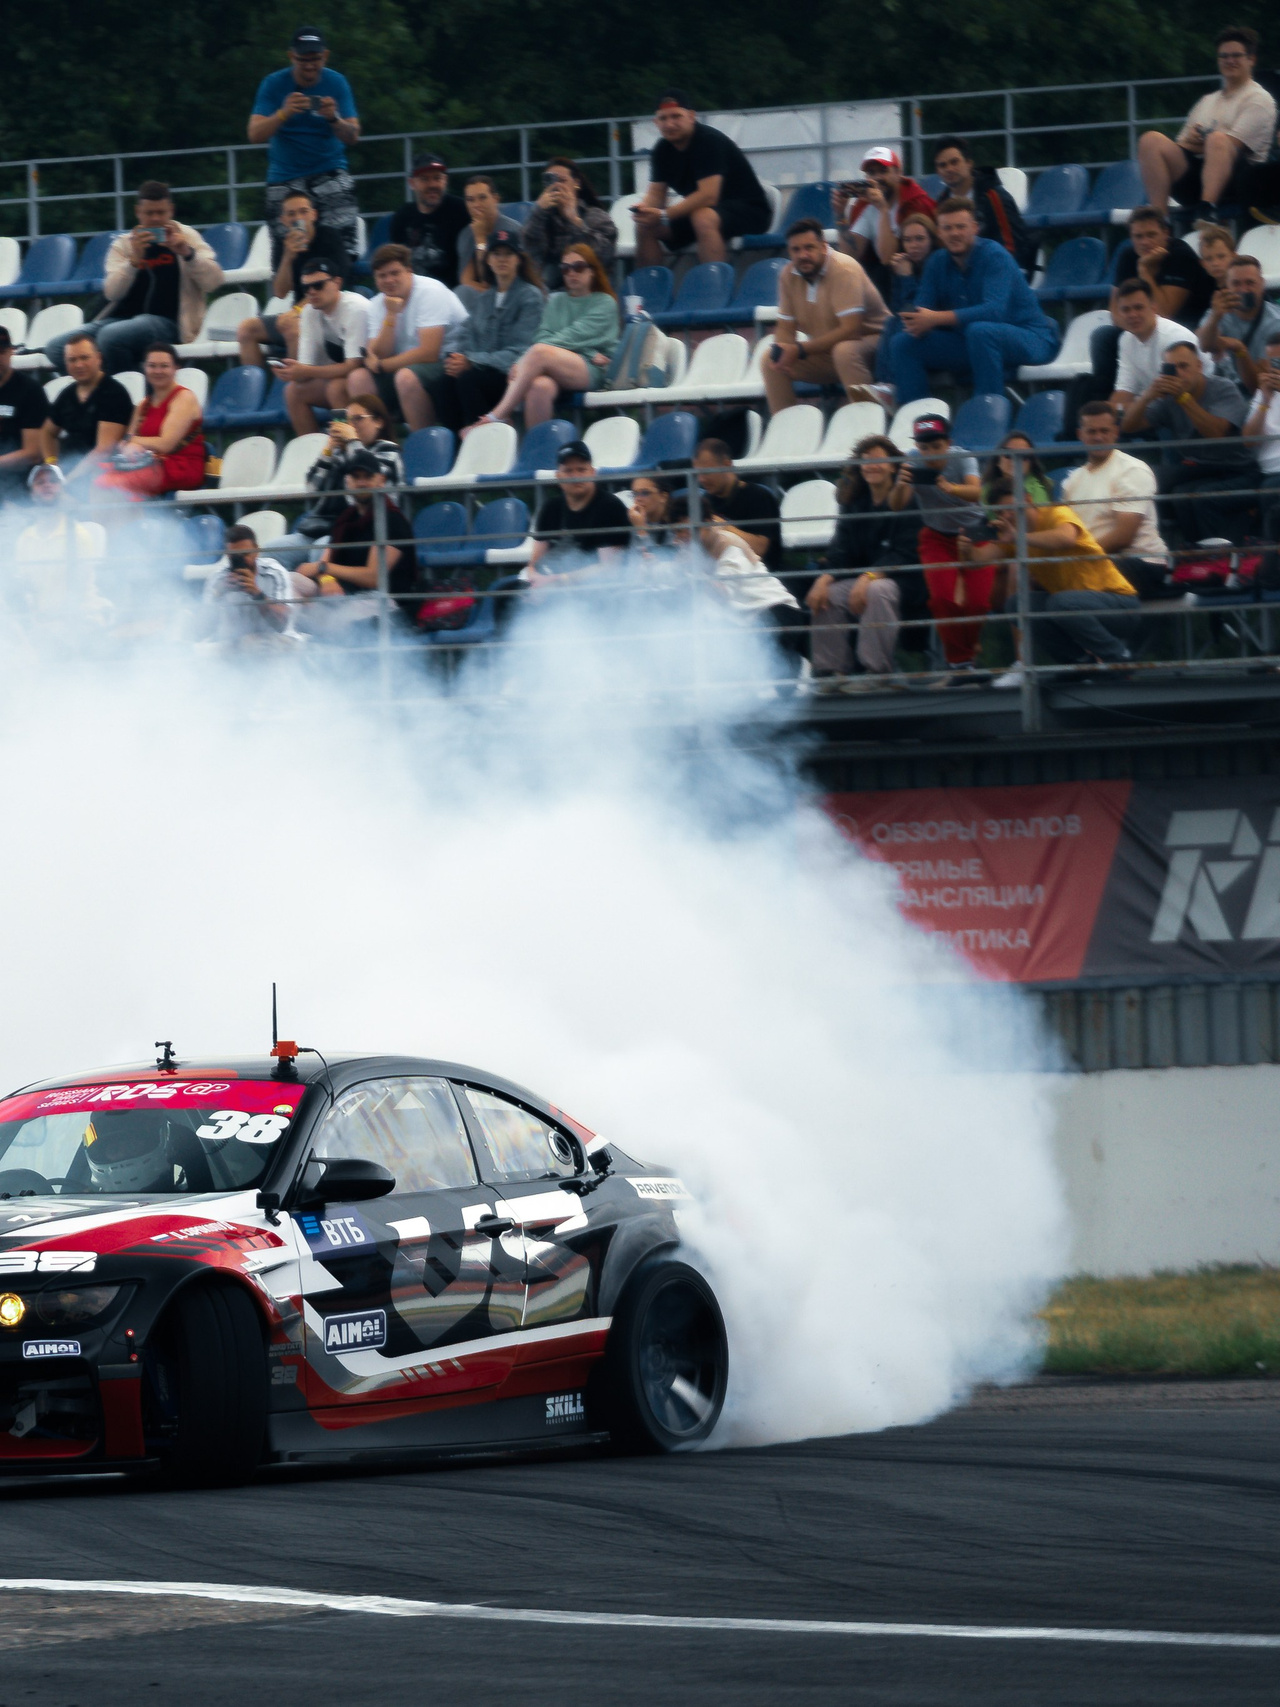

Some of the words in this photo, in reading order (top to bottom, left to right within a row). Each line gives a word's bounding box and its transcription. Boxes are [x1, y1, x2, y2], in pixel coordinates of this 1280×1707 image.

[871, 820, 976, 844] ОБЗОРЫ
[983, 814, 1082, 840] ЭТАПОВ
[87, 1083, 192, 1102] RDS
[182, 1082, 231, 1095] GP
[195, 1110, 290, 1144] 38
[320, 1217, 366, 1246] ВТБ
[325, 1318, 384, 1347] AIMOL
[26, 1344, 78, 1356] AIMOL
[271, 1364, 299, 1385] 38
[545, 1393, 584, 1418] SKILL
